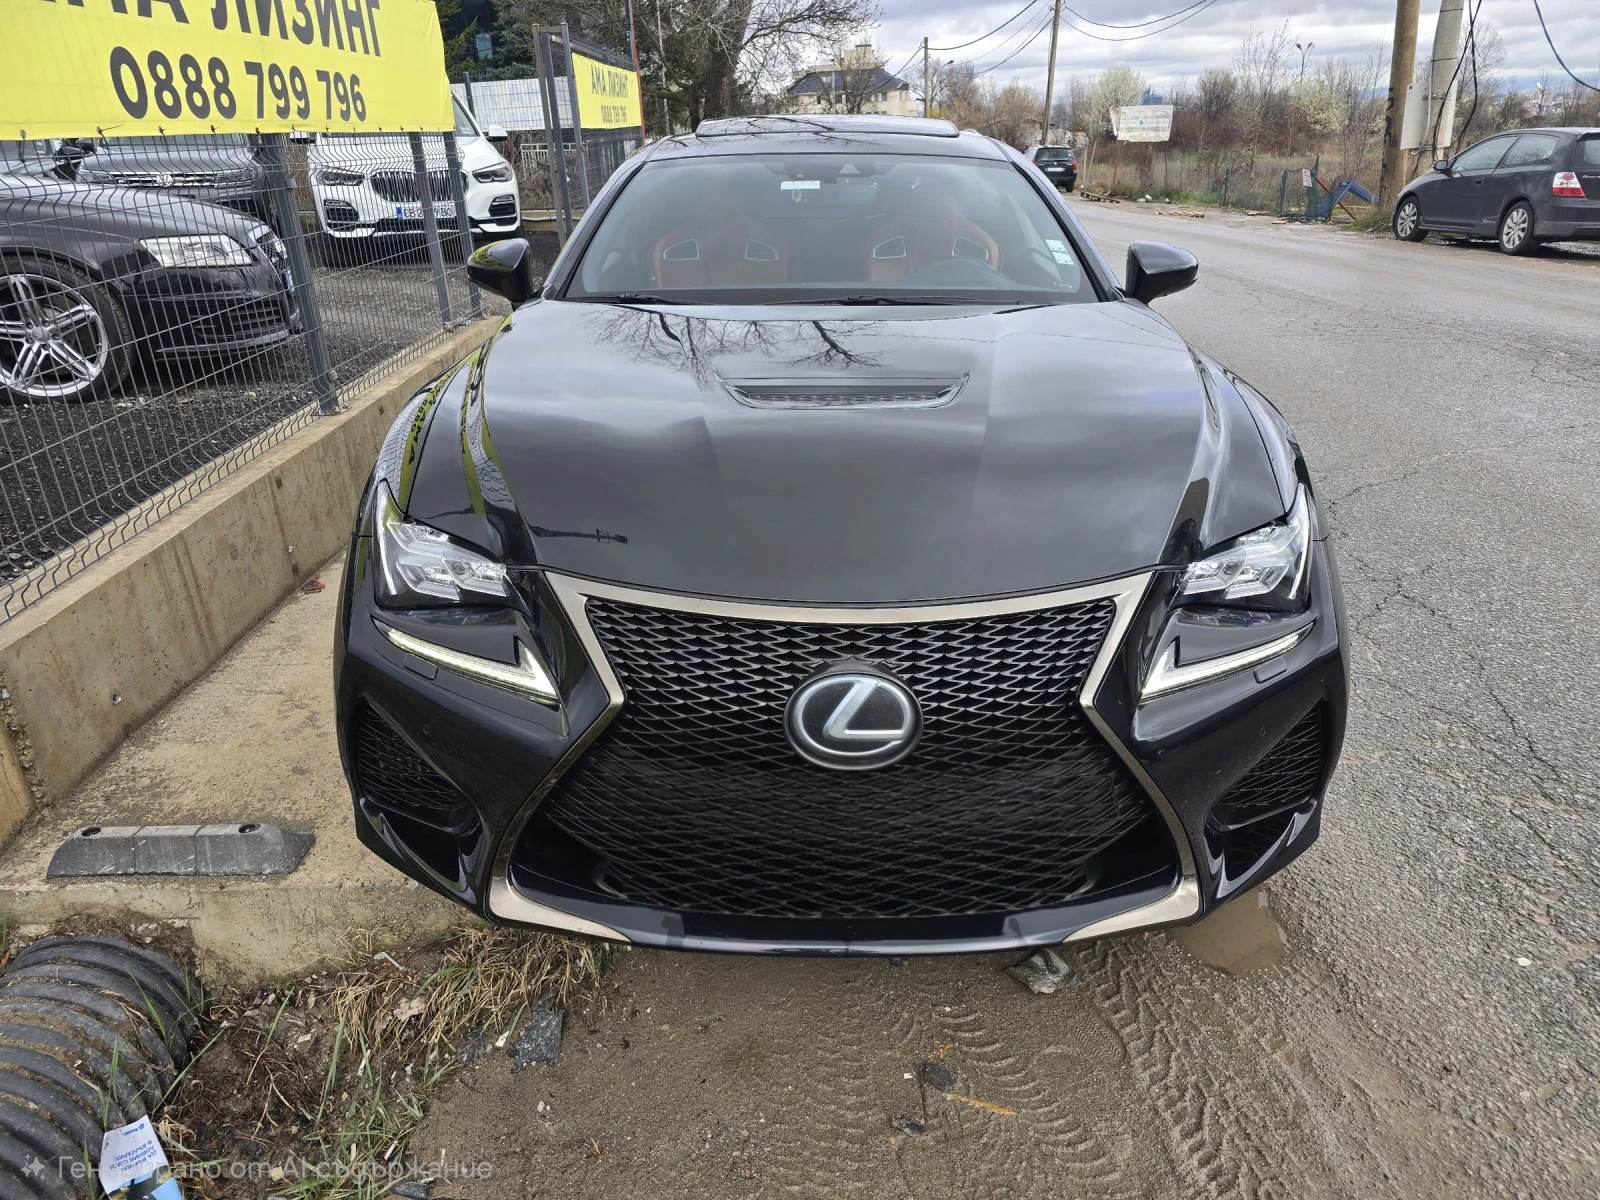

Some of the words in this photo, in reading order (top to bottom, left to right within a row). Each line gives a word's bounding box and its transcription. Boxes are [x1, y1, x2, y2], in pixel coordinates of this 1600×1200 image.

[109, 46, 237, 120] 0888
[244, 60, 310, 120] 799
[316, 69, 367, 122] 796
[591, 65, 607, 97] АМА
